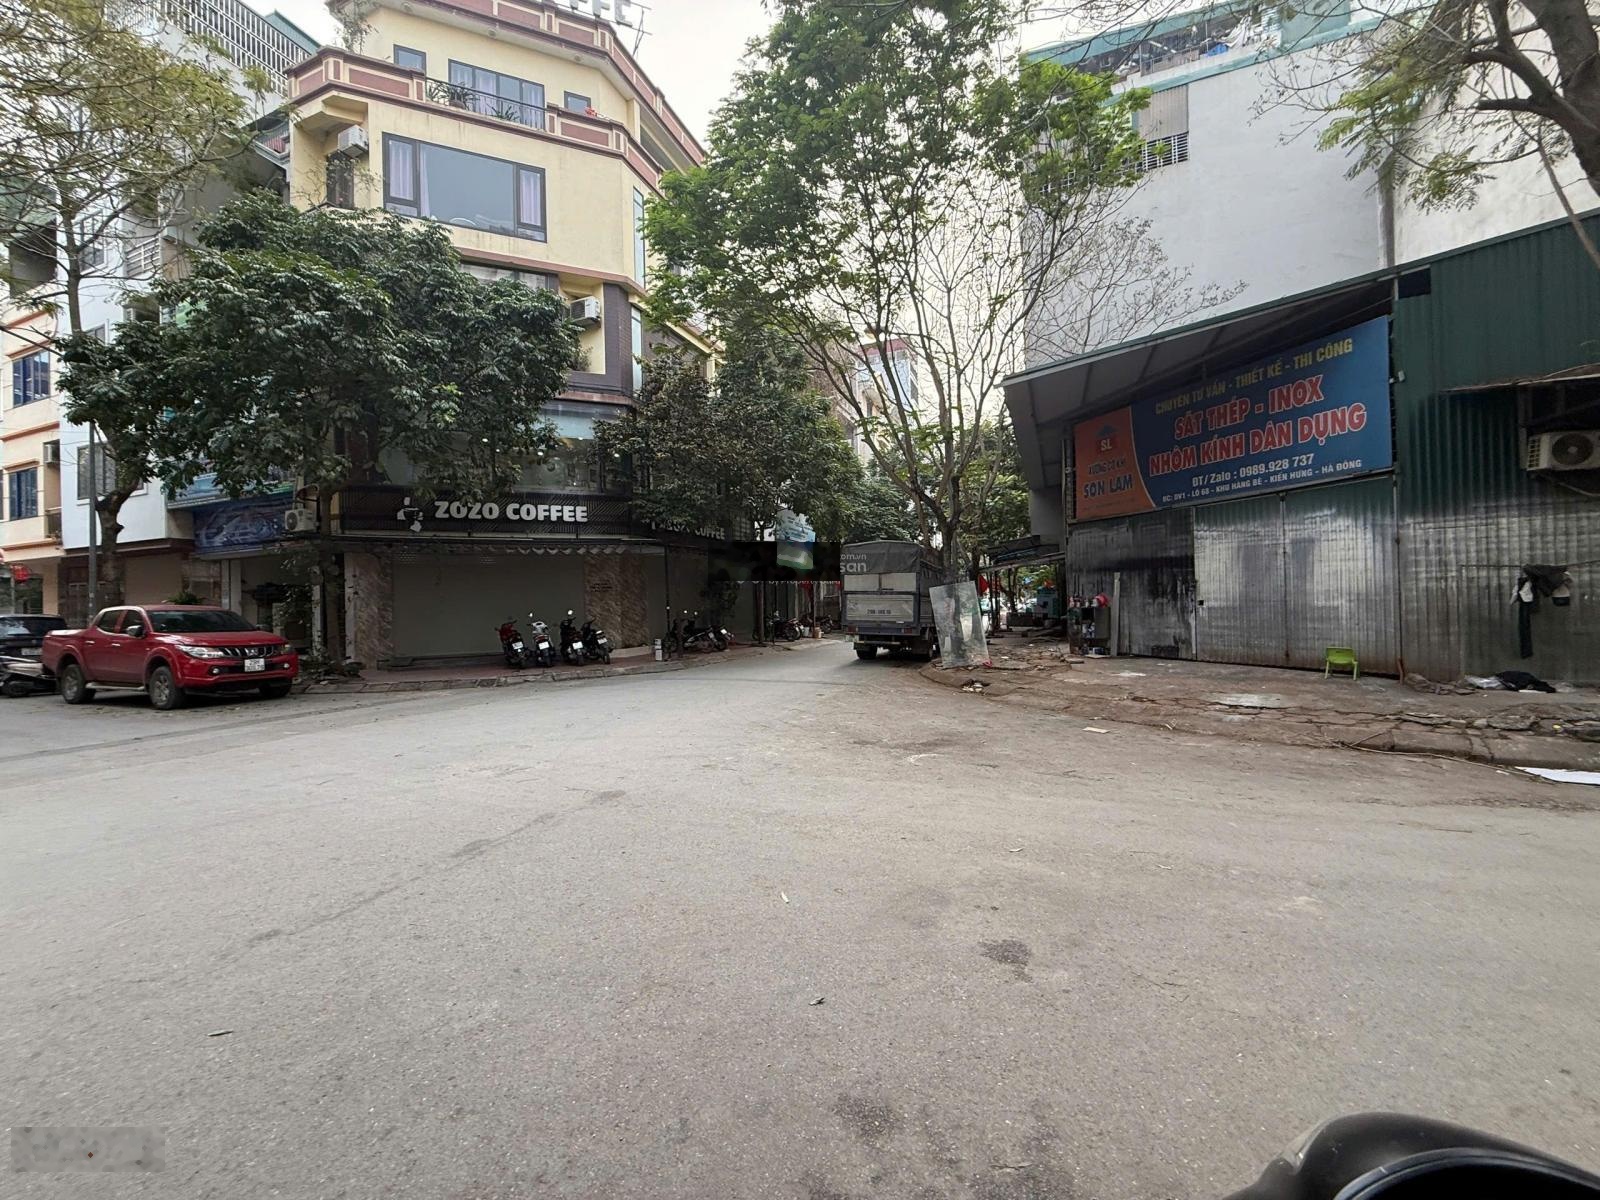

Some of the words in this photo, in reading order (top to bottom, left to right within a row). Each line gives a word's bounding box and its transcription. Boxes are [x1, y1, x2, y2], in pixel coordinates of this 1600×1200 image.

[1235, 364, 1264, 388] THIẾT
[1267, 356, 1283, 378] KẾ
[1293, 351, 1313, 369] THI
[1316, 337, 1353, 362] CÔNG
[1206, 395, 1251, 431] THÉP
[1268, 374, 1324, 414] INOX
[1149, 444, 1197, 477] NHÔM
[1200, 433, 1246, 466] KÍNH
[1249, 422, 1293, 455] DÂN
[1298, 402, 1367, 446] DỤNG
[1216, 484, 1230, 493] KHU
[1321, 463, 1334, 474] HÀ
[1336, 459, 1363, 471] ĐÔNG
[1239, 459, 1289, 478] 0989.928
[1293, 452, 1315, 467] 737
[434, 500, 500, 520] ZOZO
[505, 503, 588, 523] COFFEE
